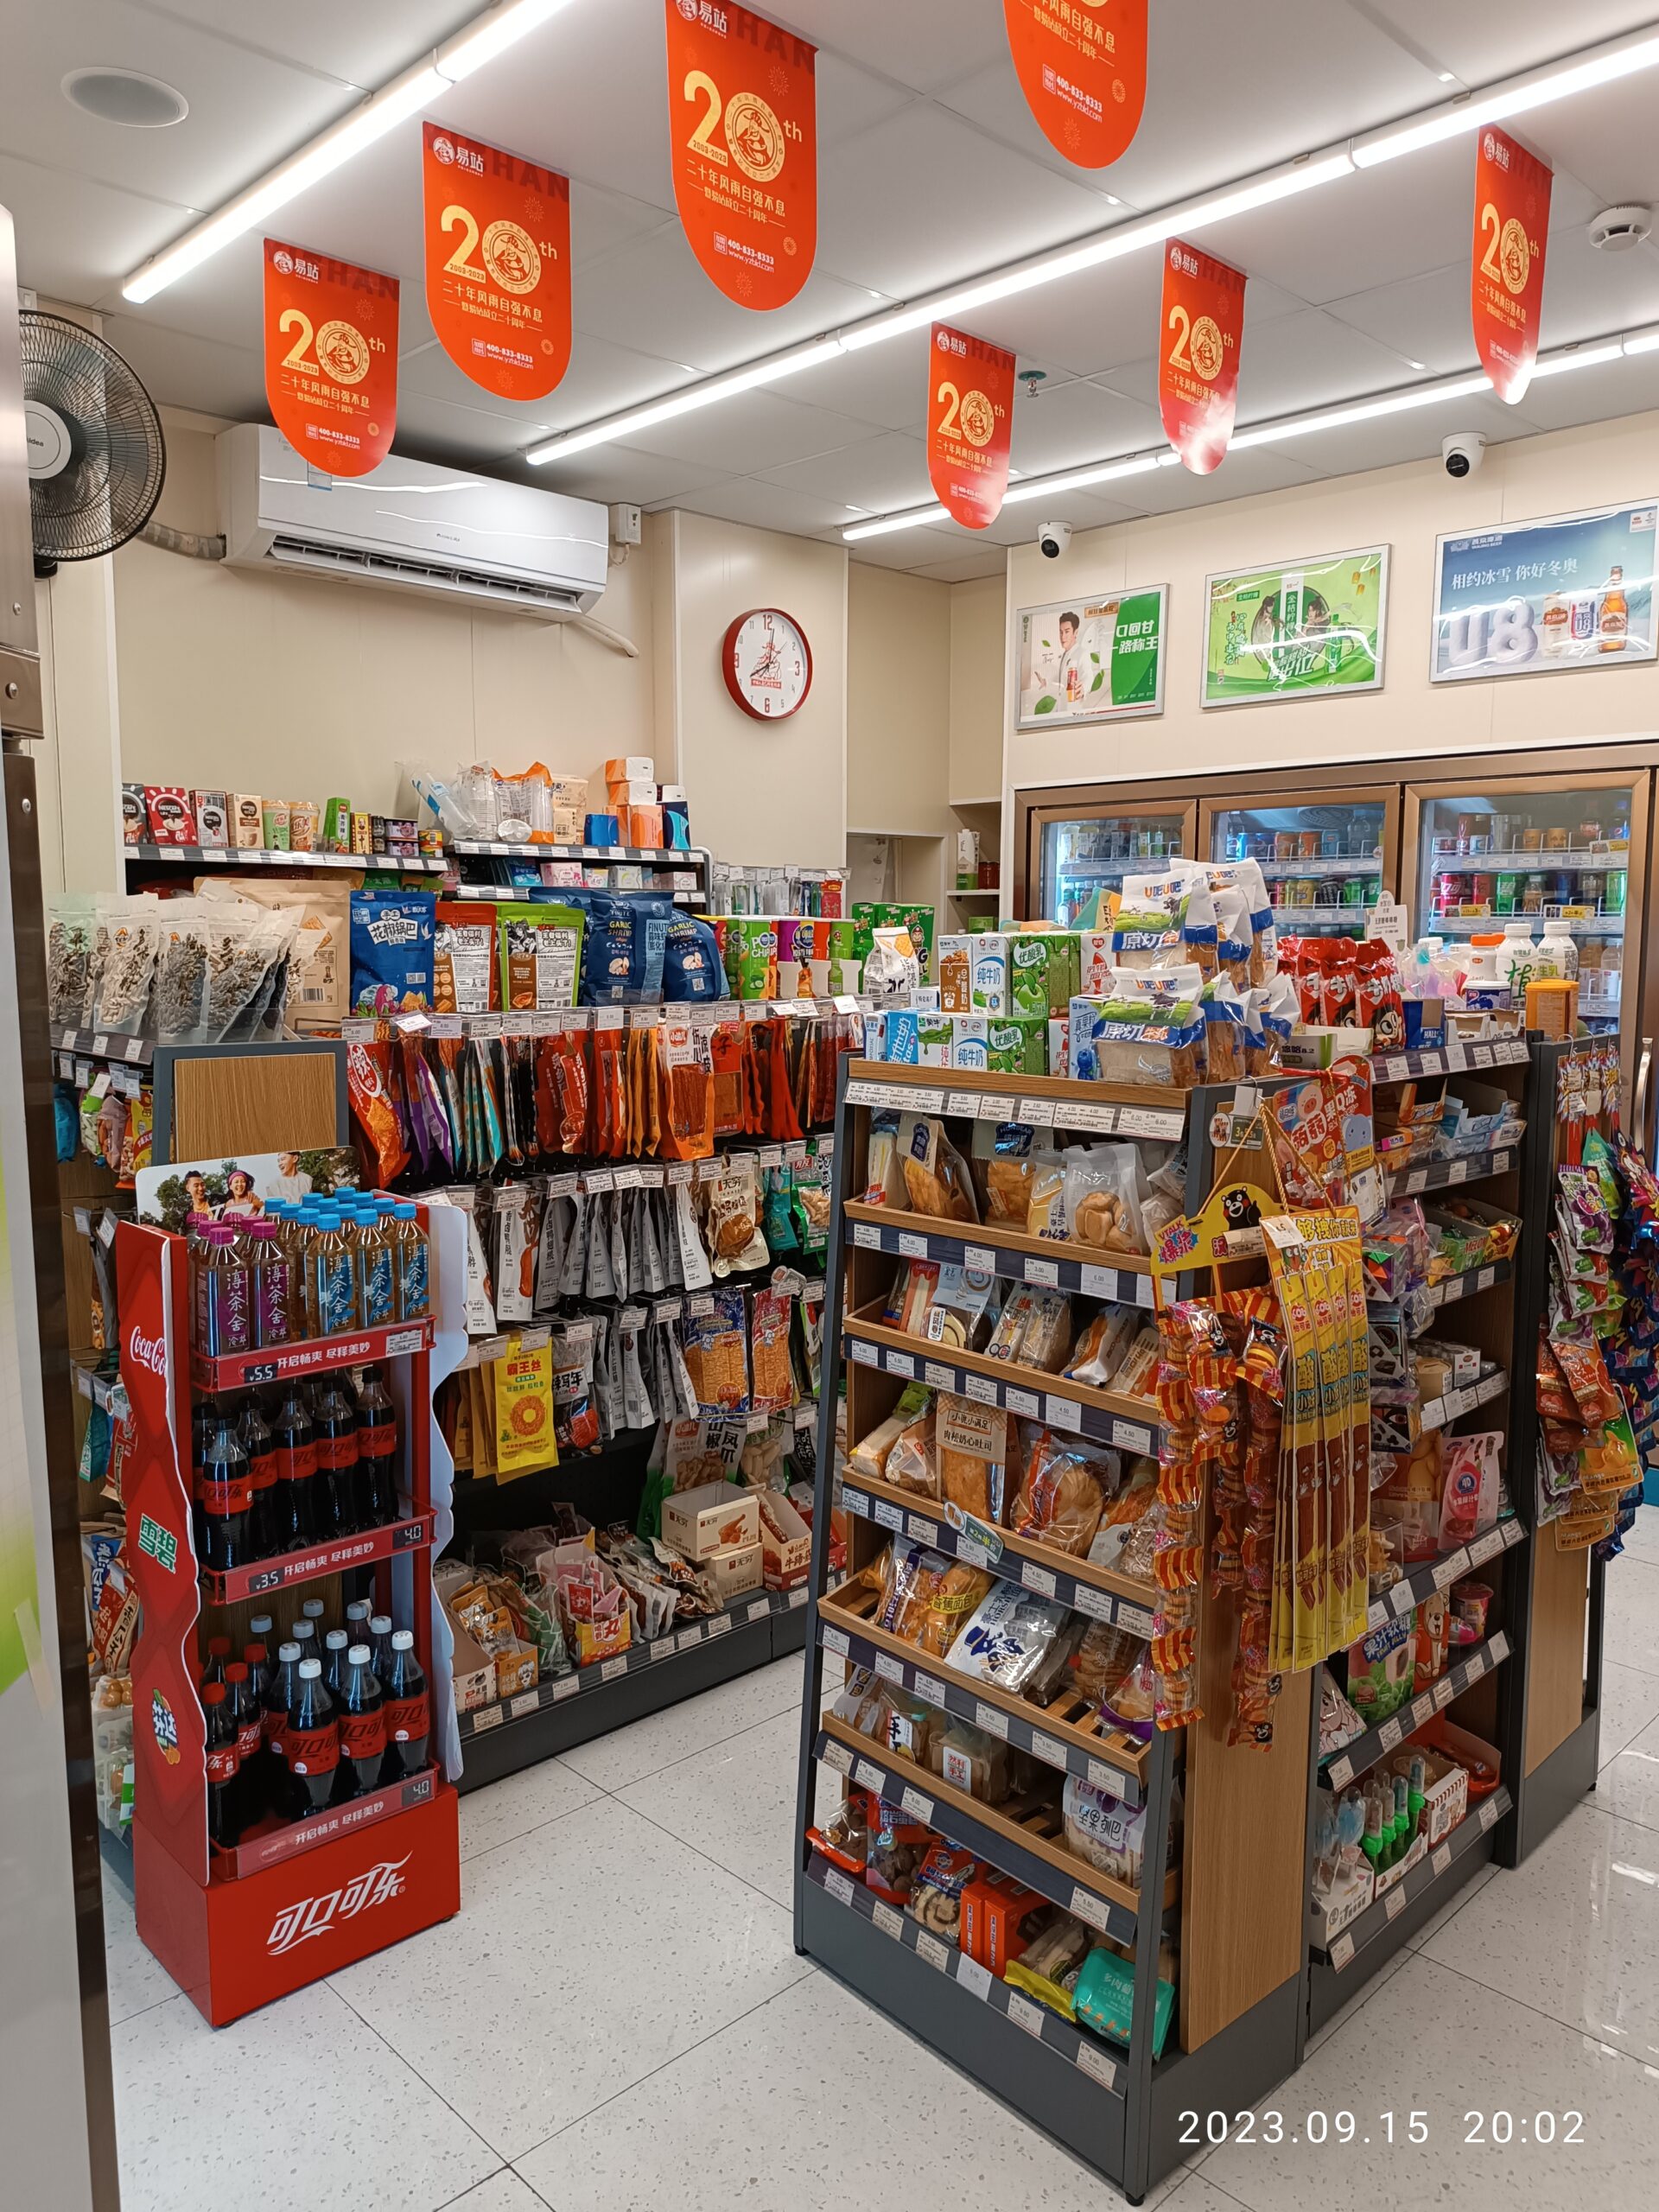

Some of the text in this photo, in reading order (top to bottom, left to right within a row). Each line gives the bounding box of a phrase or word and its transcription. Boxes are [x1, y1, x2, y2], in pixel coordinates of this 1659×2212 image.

[698, 0, 728, 33] 易站
[1057, 75, 1103, 112] 400-833-8333
[455, 146, 485, 173] 易站
[1495, 141, 1510, 168] 易站
[687, 158, 785, 217] 二十年风雨自强不息
[728, 238, 774, 264] 400-833-8333
[294, 257, 320, 281] 易站
[1181, 253, 1198, 276] 易站
[442, 279, 543, 323] 二十年风雨自强不息
[486, 344, 533, 363] 400-833-8333
[950, 337, 967, 355] 易站
[280, 373, 371, 409] 二十年风雨自强不息
[319, 428, 360, 444] 400-833-8333
[1452, 558, 1578, 590] 相约冰雪 你好冬奥
[763, 614, 772, 630] 12
[1116, 620, 1154, 638] 口回甘
[1110, 636, 1159, 654] 一路称王
[795, 660, 800, 676] 3
[765, 697, 770, 713] 6
[372, 922, 416, 941] 花椒锅巴
[609, 920, 632, 929] GARLIC
[668, 921, 695, 933] GARLIC
[670, 929, 697, 939] SHRIMP
[1019, 948, 1045, 963] 优酸乳
[977, 968, 1001, 985] 纯牛奶
[995, 1031, 1020, 1046] 优酸乳
[958, 1048, 983, 1067] 纯牛奶
[372, 1248, 389, 1306] 淳茶舍
[408, 1244, 425, 1300] 淳茶舍
[267, 1262, 287, 1325] 淳茶舍
[328, 1254, 348, 1314] 淳茶舍
[226, 1268, 247, 1332] 淳茶舍
[130, 1325, 167, 1378] Coca-Co
[277, 1341, 371, 1370] 开启畅爽 尽释美妙
[506, 1359, 542, 1376] 霸王丝
[944, 1430, 992, 1452] 肉松奶心吐司
[138, 1512, 177, 1574] 雪碧
[404, 1525, 422, 1540] 4.0
[284, 1541, 374, 1577] 开启畅爽 尽释美妙
[931, 1594, 973, 1611] 香蕉面包
[413, 1780, 429, 1794] 4.0
[295, 1801, 384, 1845] 开启畅爽 尽释美妙
[266, 1851, 413, 1955] 可口可乐
